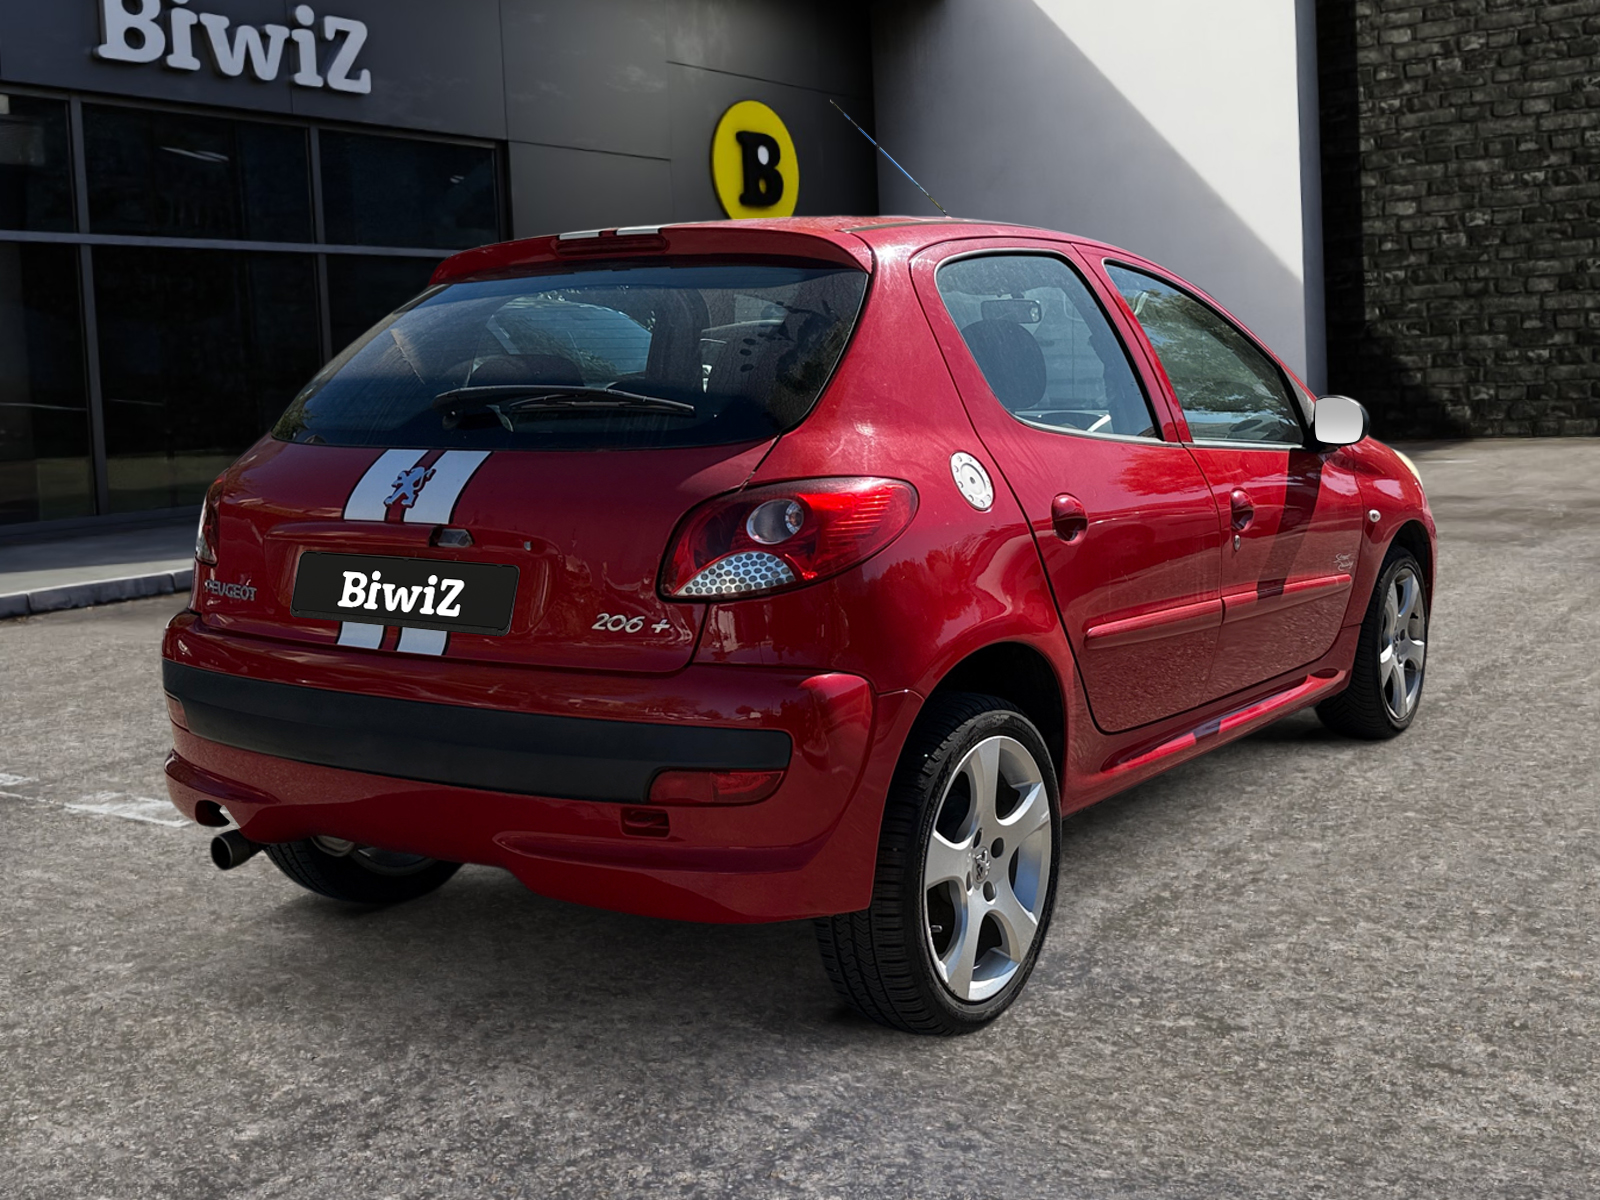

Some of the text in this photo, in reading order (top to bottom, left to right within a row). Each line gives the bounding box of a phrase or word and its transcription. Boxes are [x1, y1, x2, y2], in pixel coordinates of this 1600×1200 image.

[97, 0, 371, 94] BiwiZ
[735, 130, 784, 208] B
[204, 579, 257, 601] PEUGEOT
[337, 570, 465, 617] BiwiZ
[591, 612, 645, 633] 206
